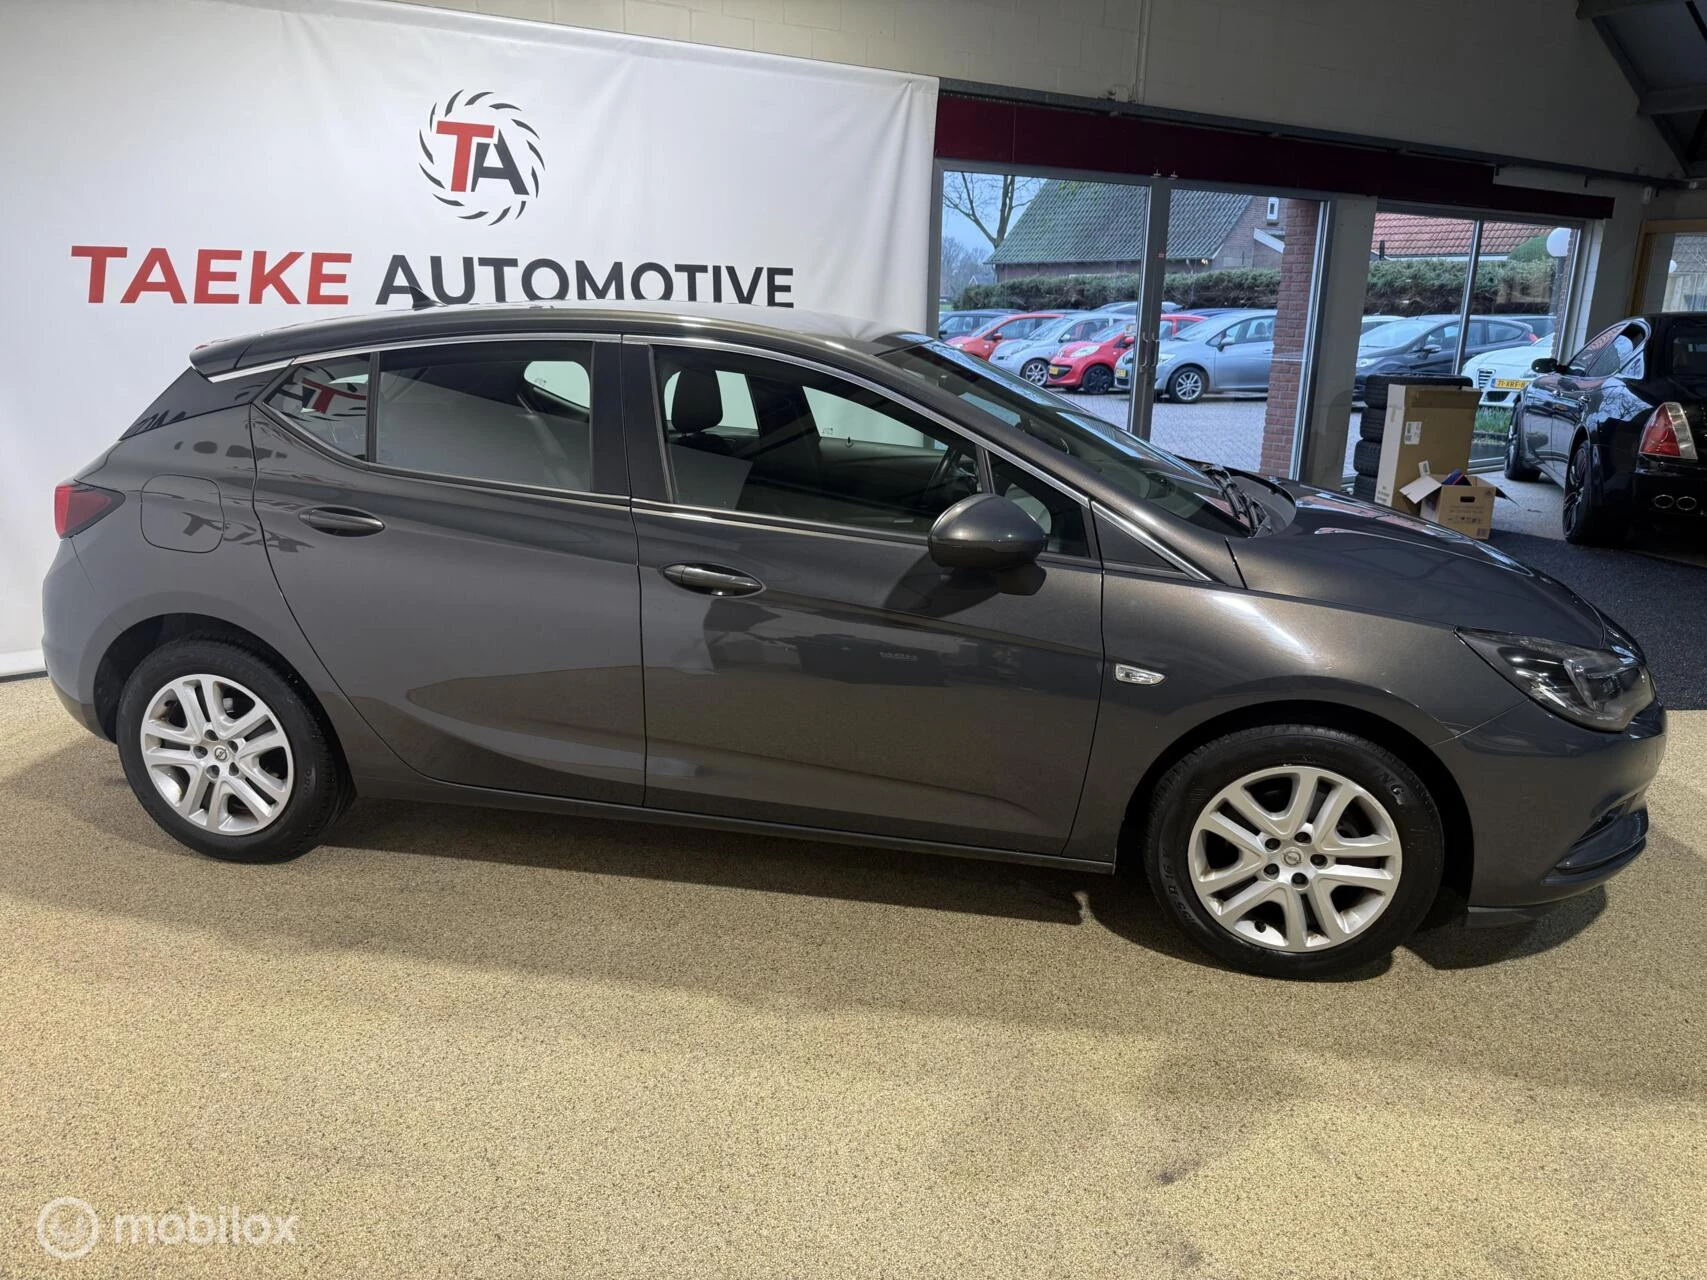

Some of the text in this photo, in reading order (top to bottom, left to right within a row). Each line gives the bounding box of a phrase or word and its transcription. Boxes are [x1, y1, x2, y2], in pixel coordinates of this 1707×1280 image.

[436, 120, 530, 196] TA
[71, 245, 795, 308] TAEKE AUTOMOTIVE
